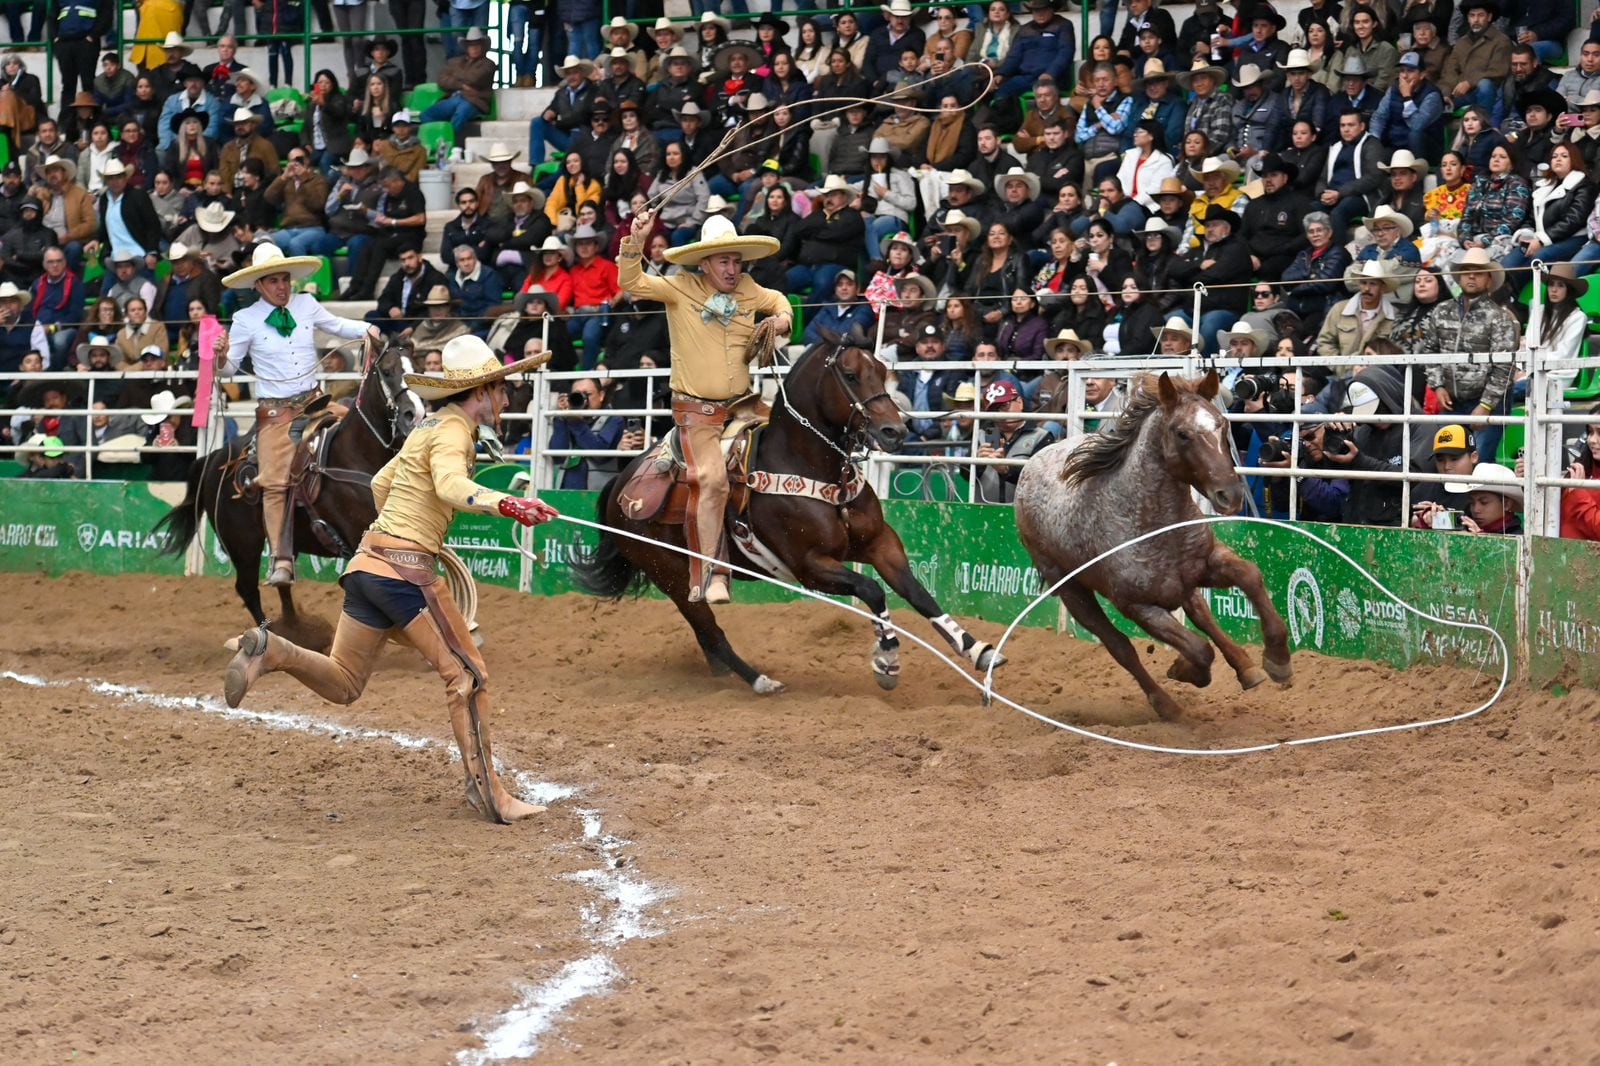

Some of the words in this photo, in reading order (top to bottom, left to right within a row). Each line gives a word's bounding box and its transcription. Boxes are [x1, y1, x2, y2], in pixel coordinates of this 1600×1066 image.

[99, 530, 171, 549] ARIAT
[448, 536, 499, 547] NISSAN
[1429, 603, 1489, 625] NISSAN
